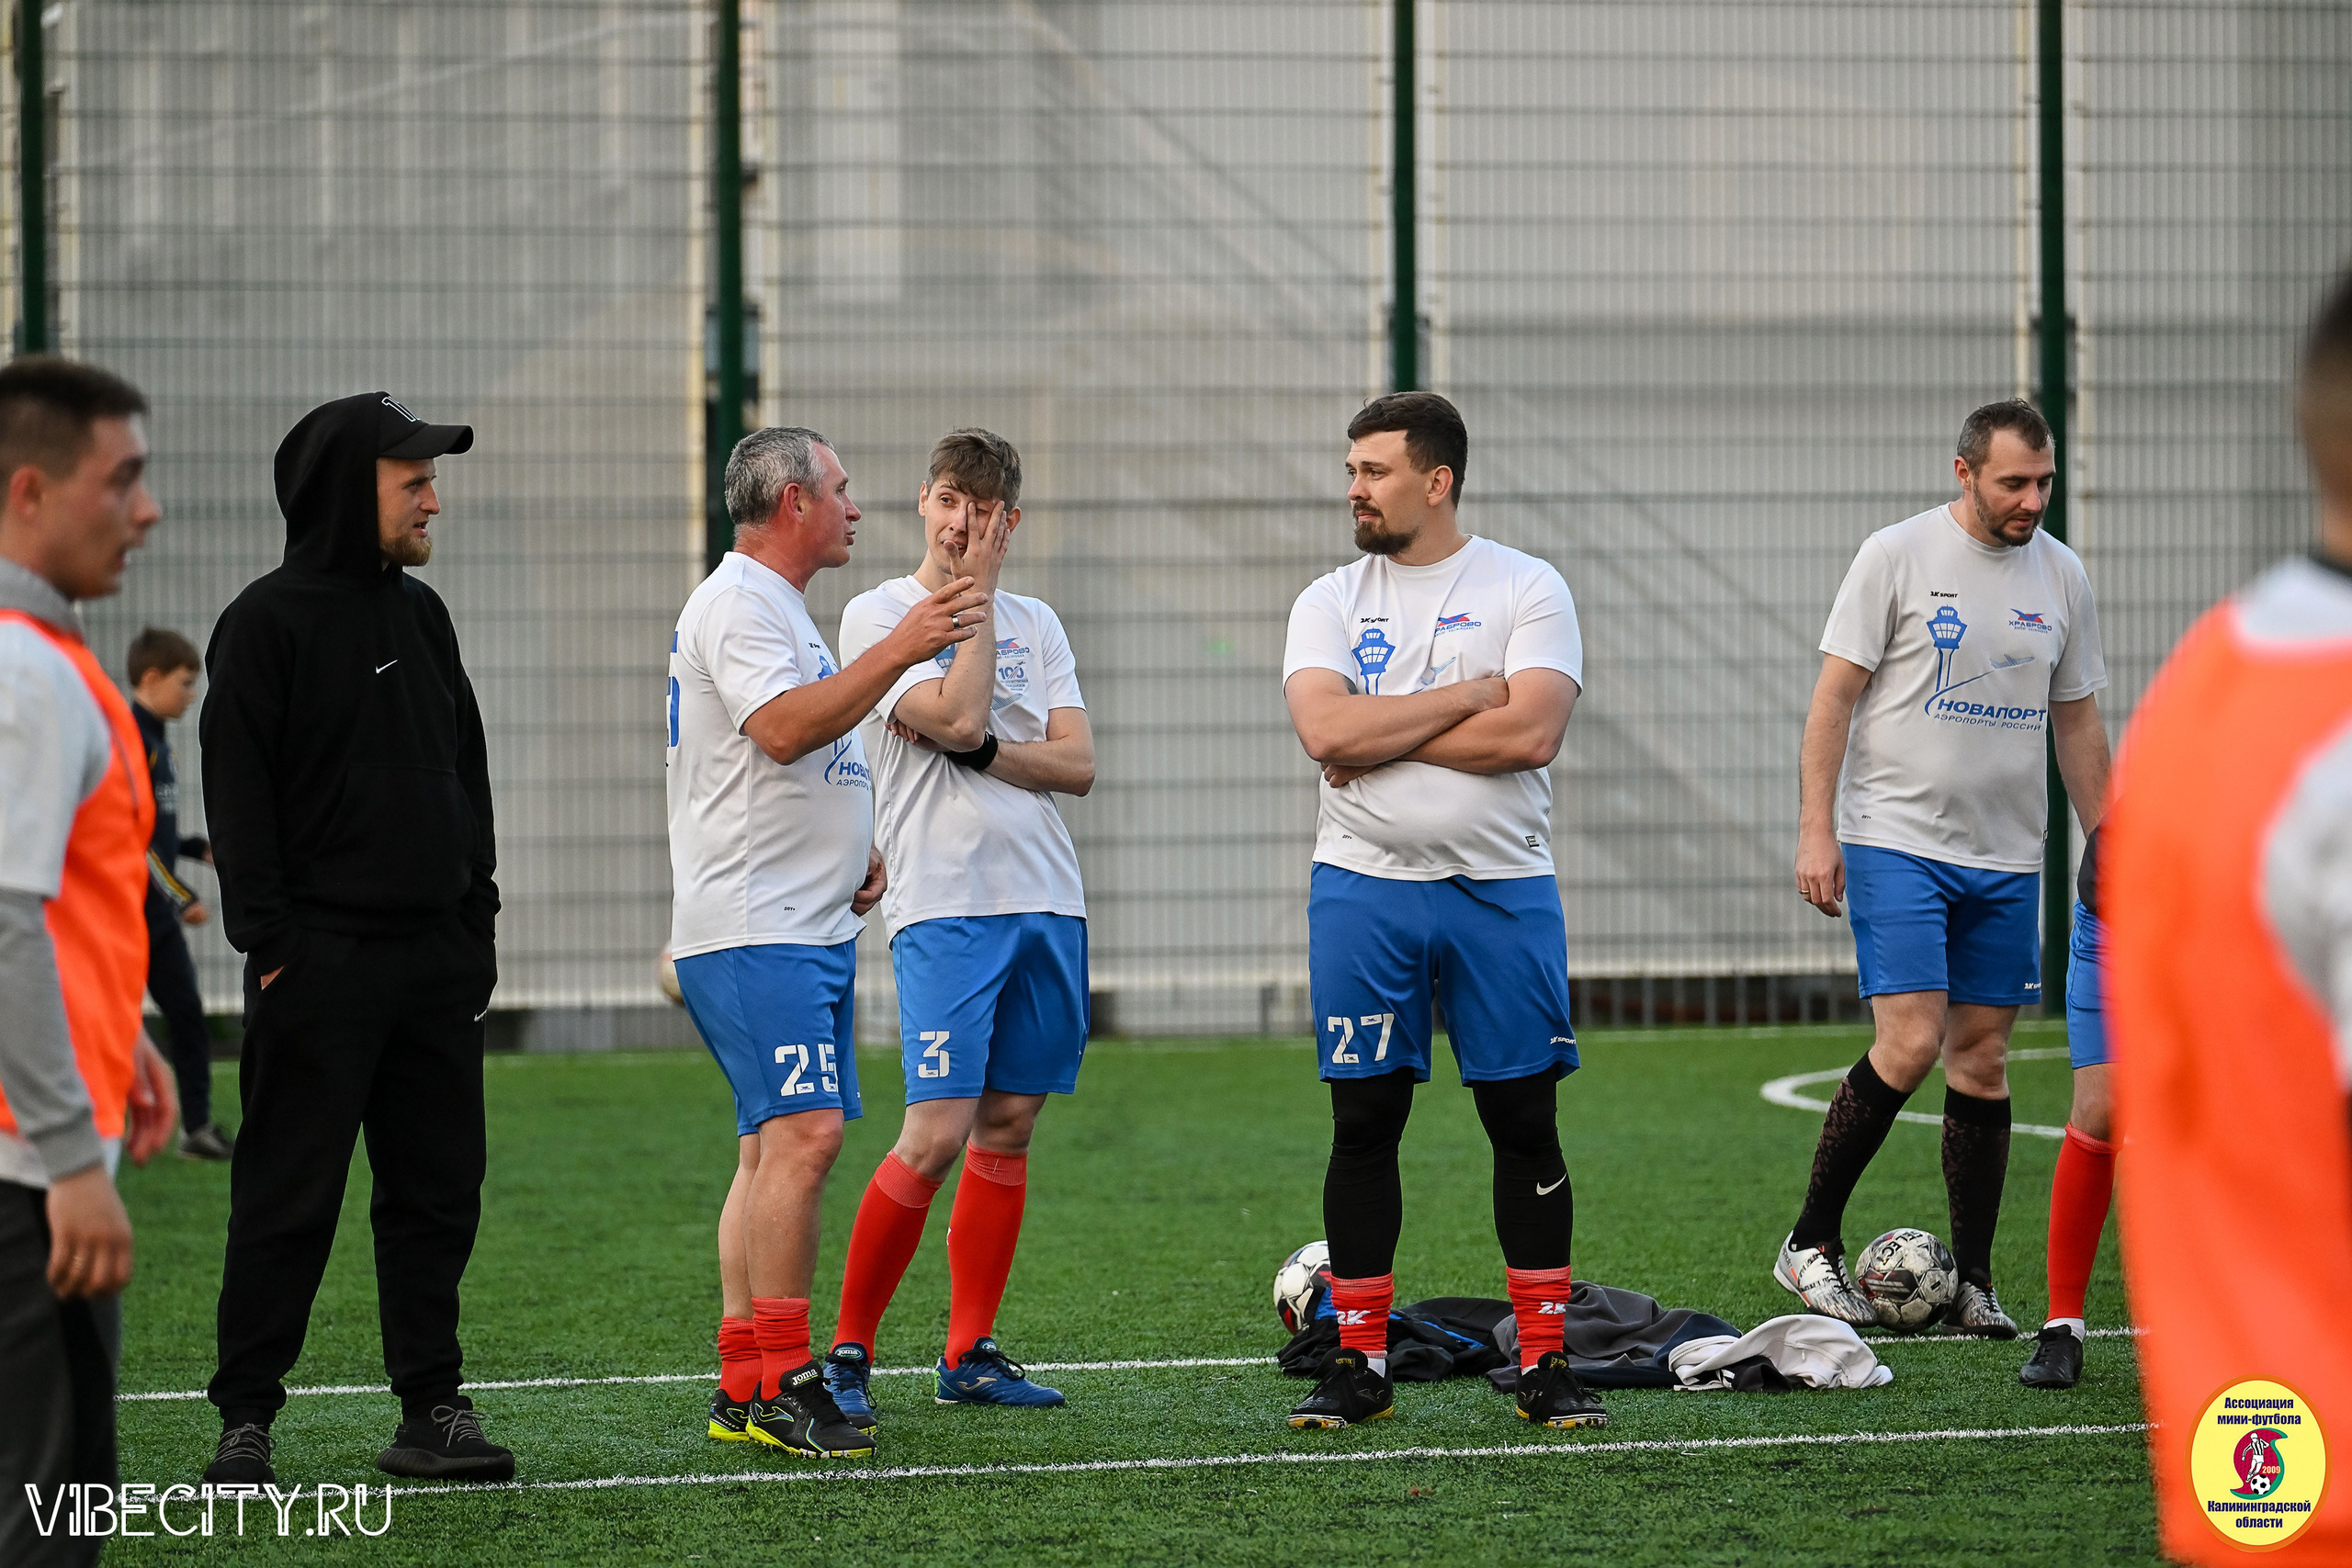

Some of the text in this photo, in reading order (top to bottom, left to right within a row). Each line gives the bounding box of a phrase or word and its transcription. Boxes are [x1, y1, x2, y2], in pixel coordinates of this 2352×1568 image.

[1434, 621, 1482, 635] РАБРОВО
[2008, 620, 2052, 631] ХРАБРОВО
[998, 666, 1024, 680] 100
[1937, 699, 2047, 722] НОВАПОРТ
[1934, 713, 2041, 731] АЭРОПОРТЫ РОССИИ
[1328, 1013, 1395, 1064] 27
[918, 1031, 950, 1078] 3
[775, 1043, 839, 1097] 25
